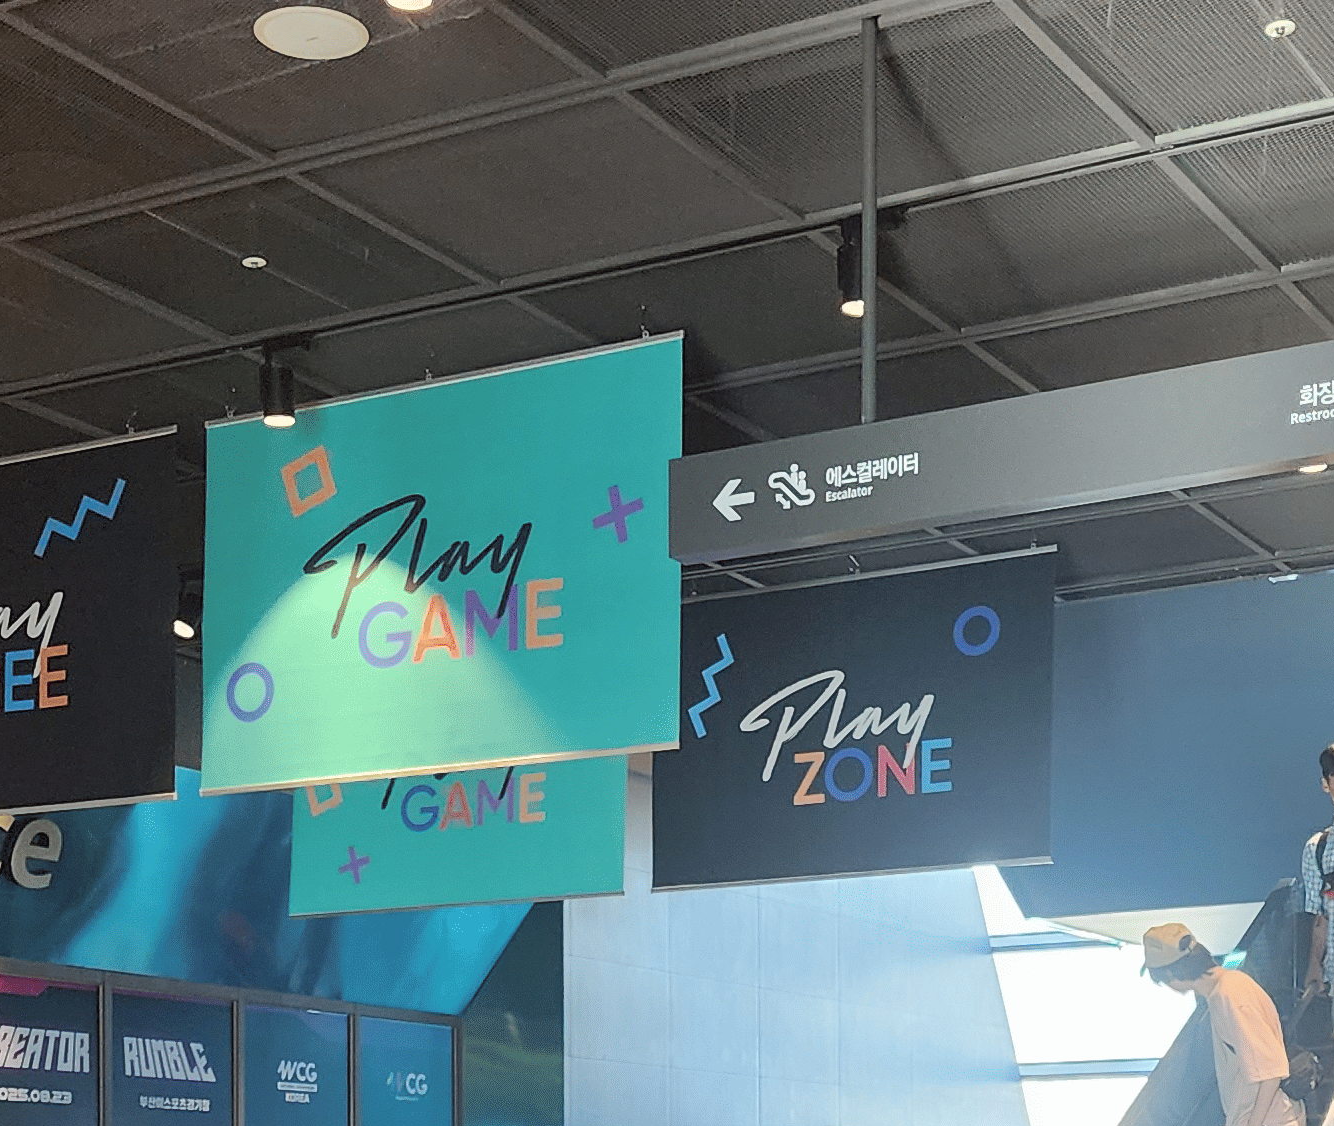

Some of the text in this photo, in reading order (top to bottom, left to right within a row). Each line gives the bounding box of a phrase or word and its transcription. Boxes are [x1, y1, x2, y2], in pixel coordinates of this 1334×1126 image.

[825, 452, 919, 487] 에스컬레이터
[825, 486, 874, 503] Escalator
[302, 494, 533, 638] Play
[358, 578, 565, 668] GAME
[739, 669, 935, 782] Play
[400, 771, 547, 832] GAME
[793, 737, 953, 806] ZONE
[123, 1036, 216, 1082] RUMBLE
[277, 1059, 317, 1083] WCG
